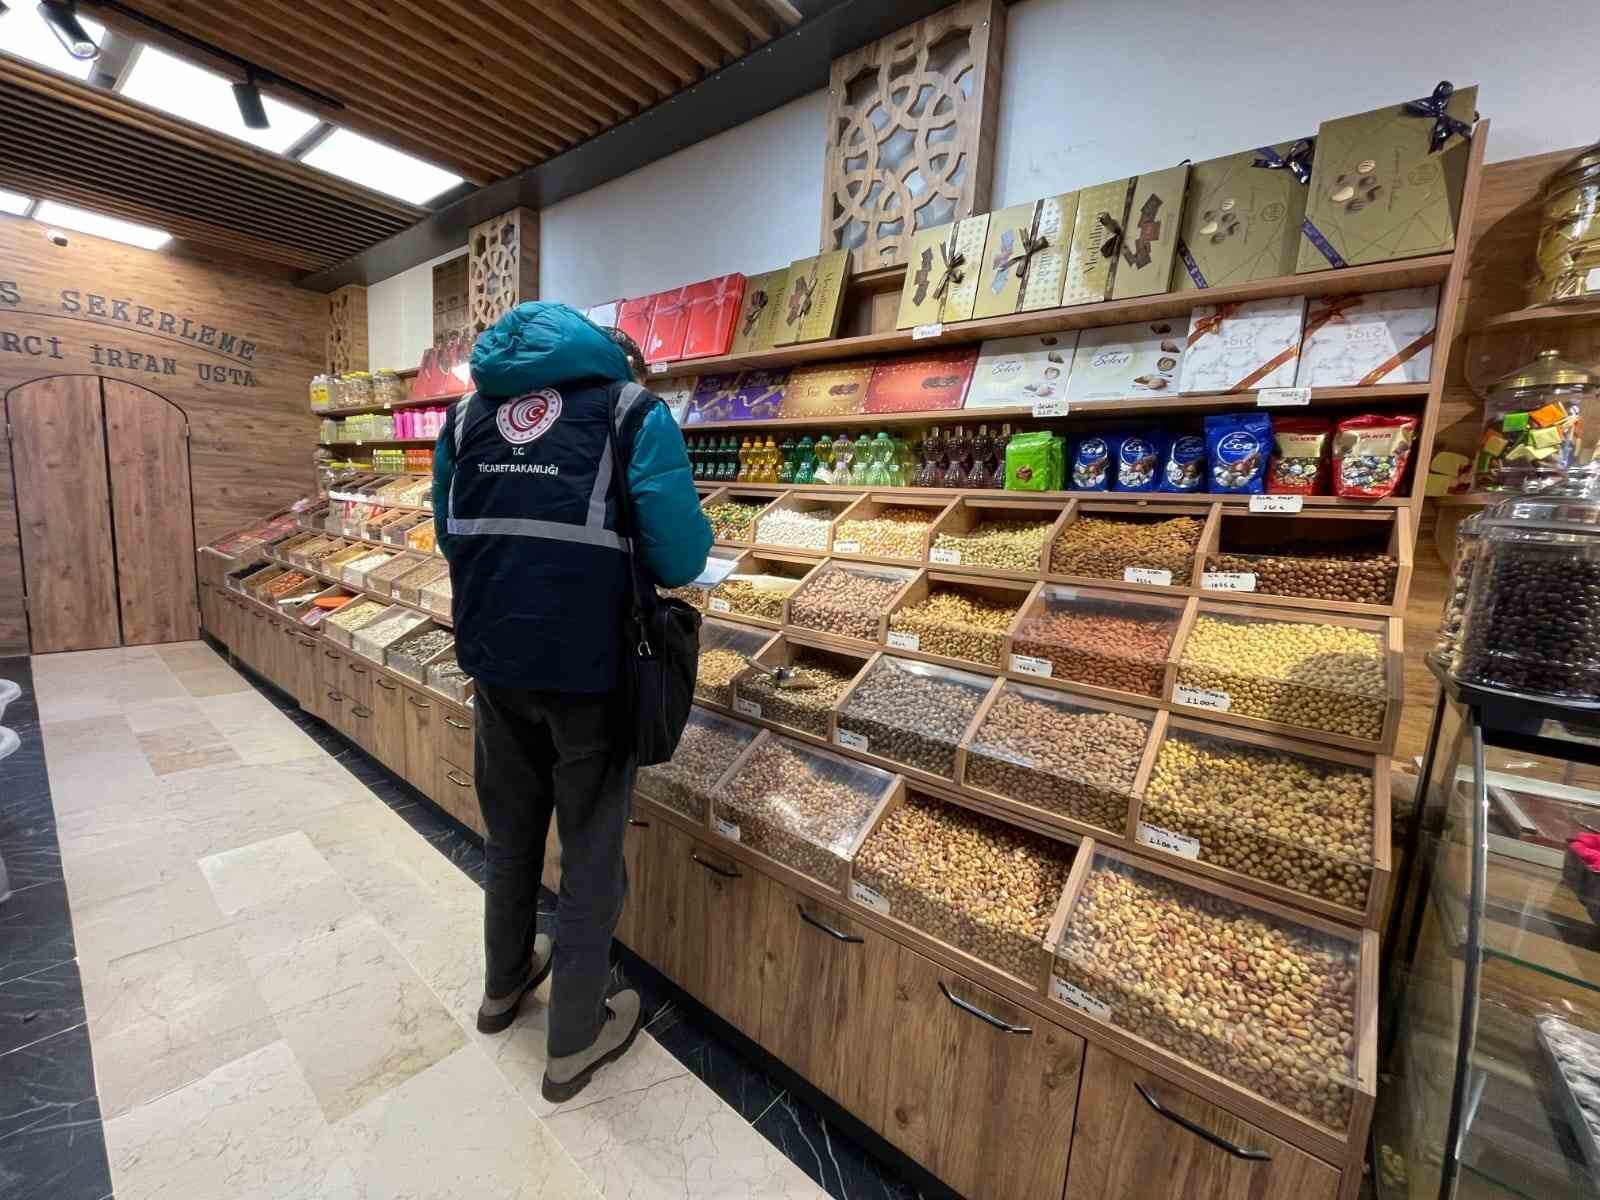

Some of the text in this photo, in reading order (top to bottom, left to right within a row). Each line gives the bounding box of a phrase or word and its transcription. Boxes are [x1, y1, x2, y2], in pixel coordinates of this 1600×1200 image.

[90, 343, 177, 376] İRFAN
[196, 362, 257, 388] USTA
[478, 462, 559, 476] TİCARET BAKANLIĞI
